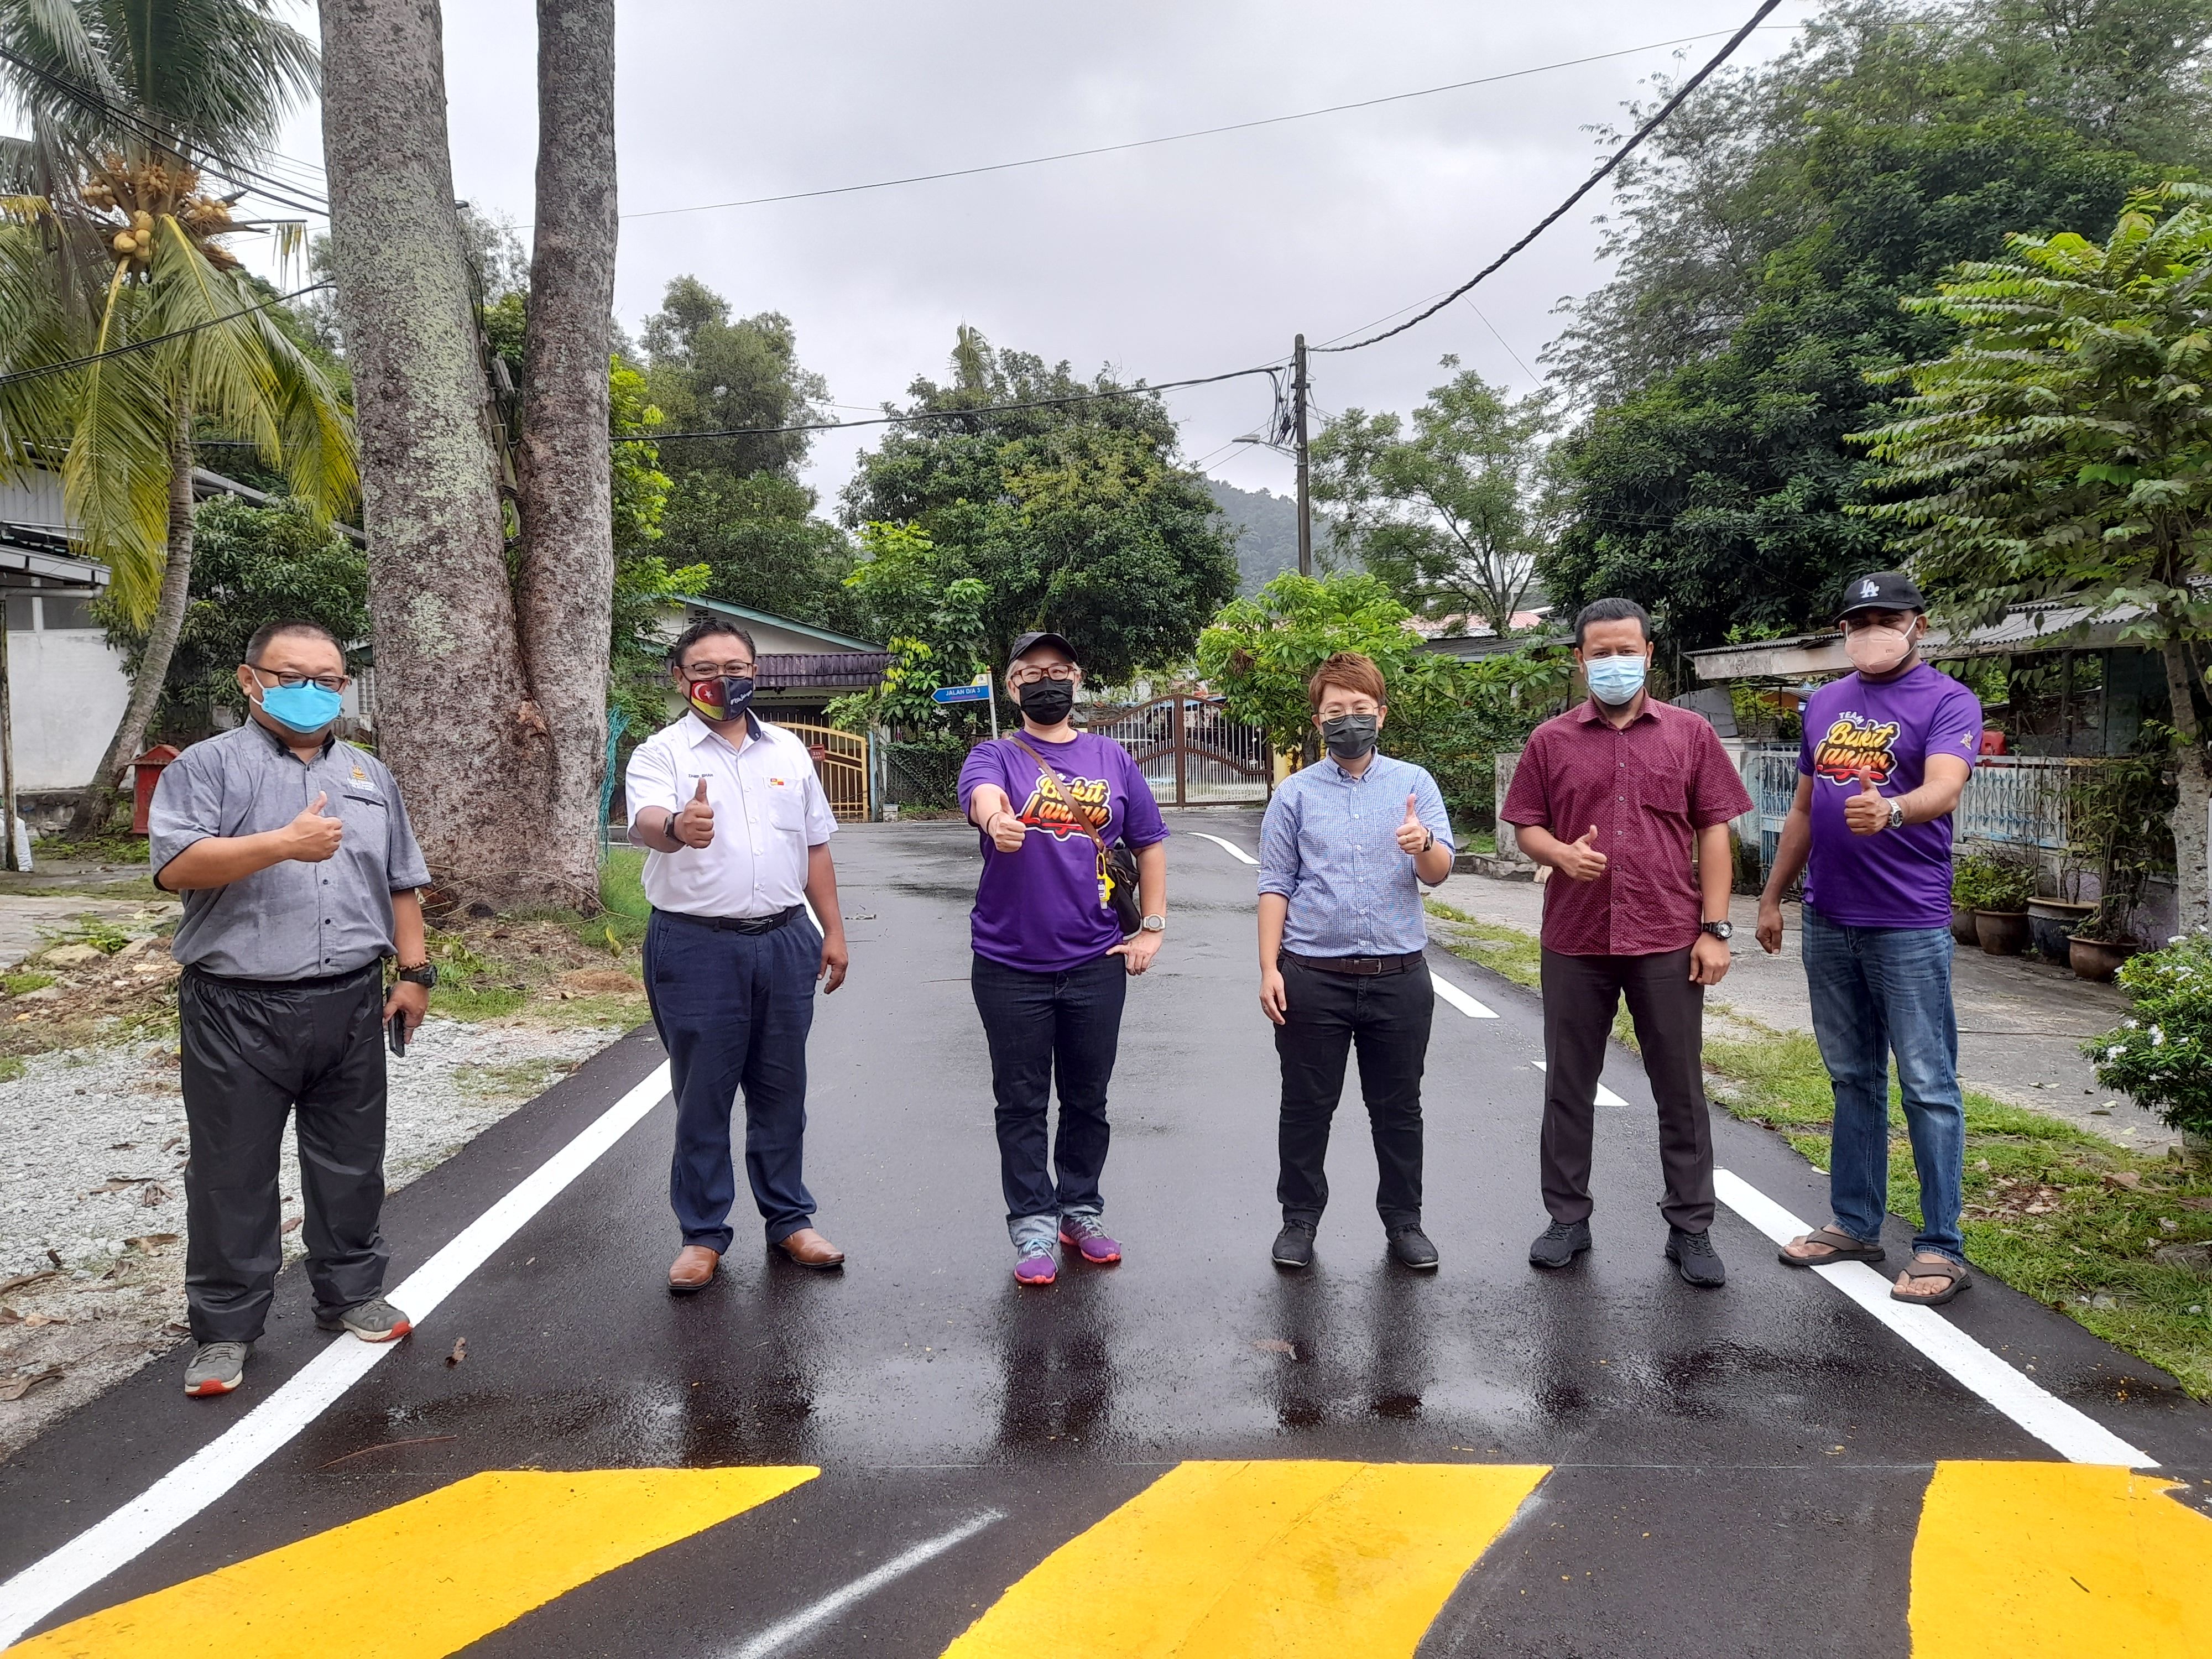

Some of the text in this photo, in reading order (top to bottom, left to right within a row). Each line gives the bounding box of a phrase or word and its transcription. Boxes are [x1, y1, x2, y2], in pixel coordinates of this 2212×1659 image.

[1860, 579, 1880, 598] LA
[1839, 711, 1865, 724] TEAM
[1828, 722, 1894, 748] Bukit
